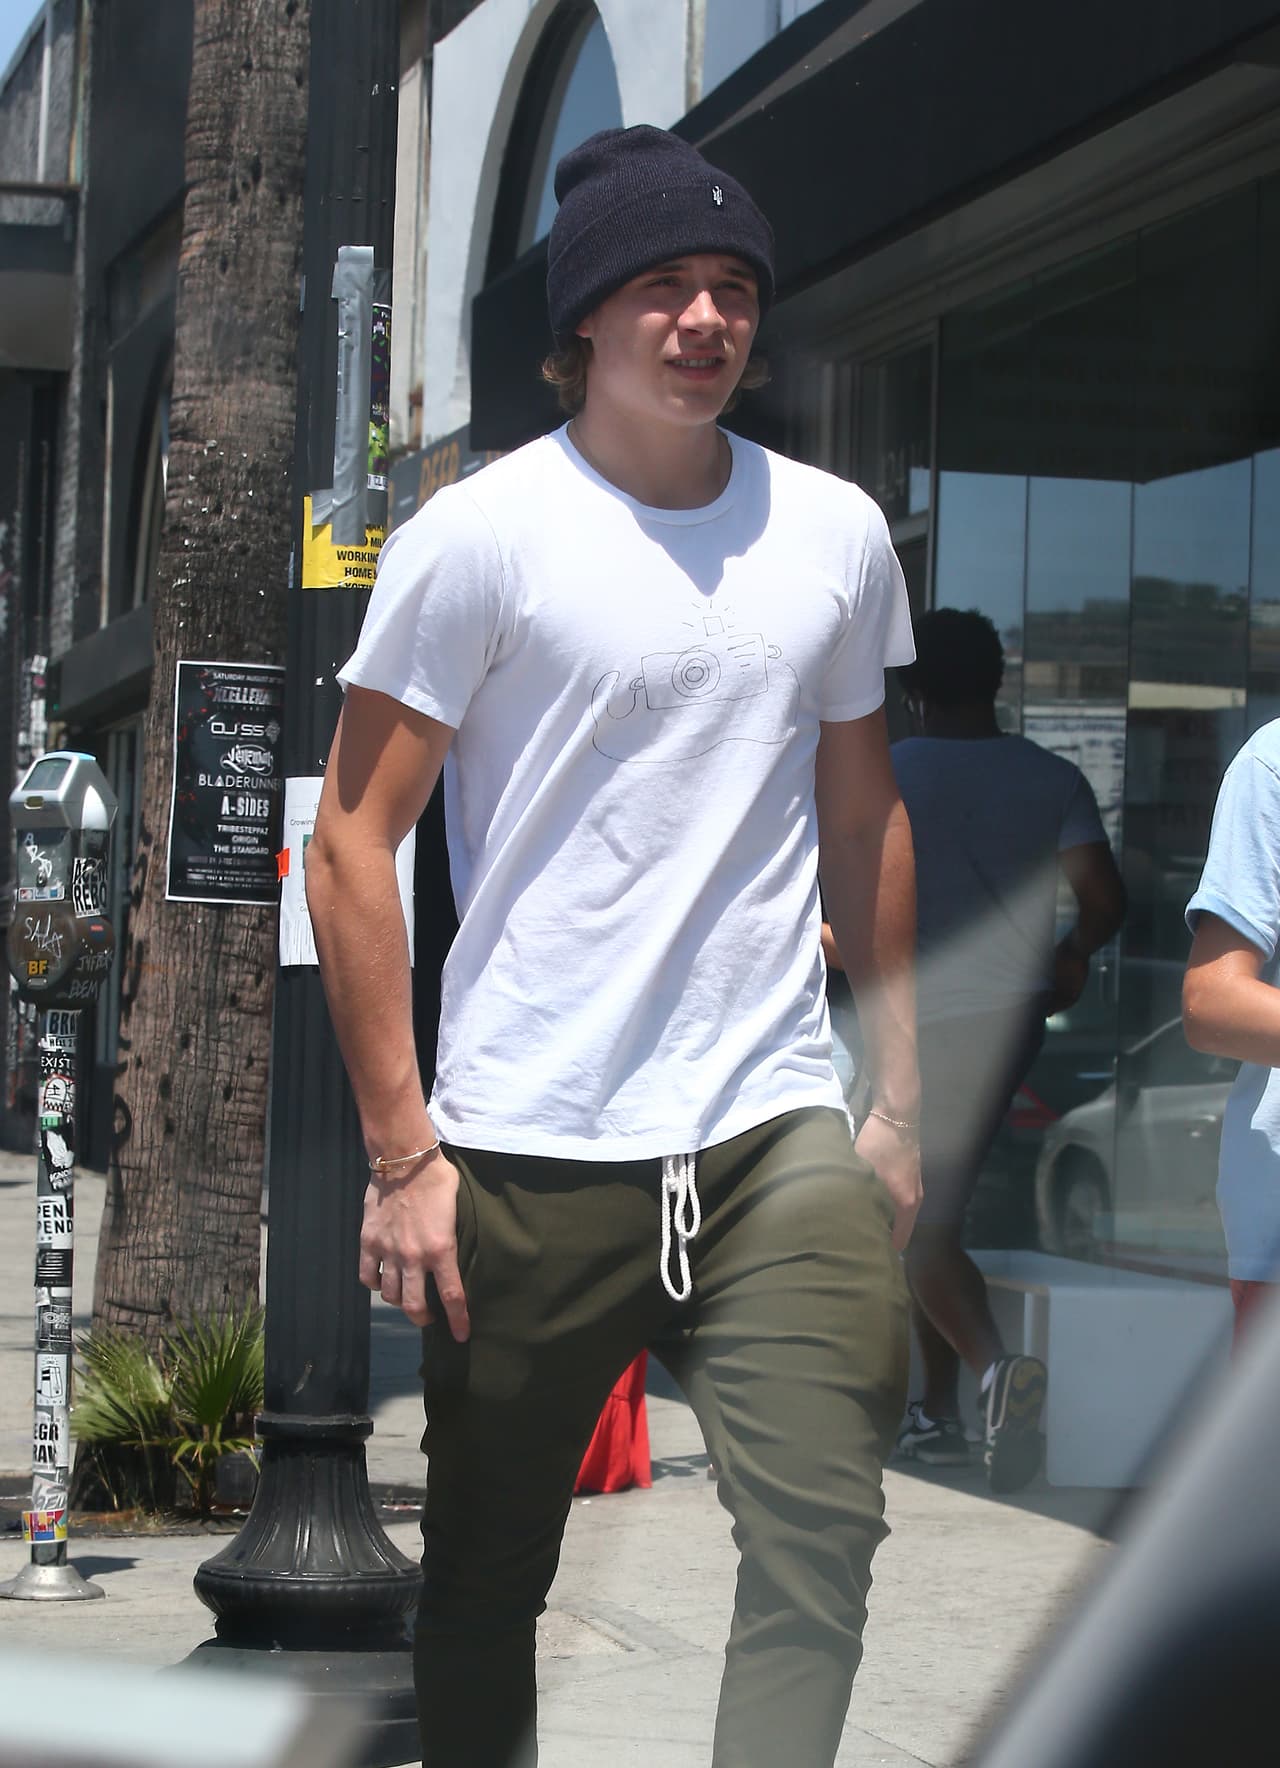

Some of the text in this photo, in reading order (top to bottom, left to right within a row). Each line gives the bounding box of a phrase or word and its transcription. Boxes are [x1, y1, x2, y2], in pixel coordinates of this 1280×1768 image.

[344, 567, 372, 579] HOME
[221, 796, 270, 817] A-SIDES
[232, 835, 259, 844] ORIGIN
[213, 844, 269, 855] THE STANDARD
[28, 960, 47, 976] BF
